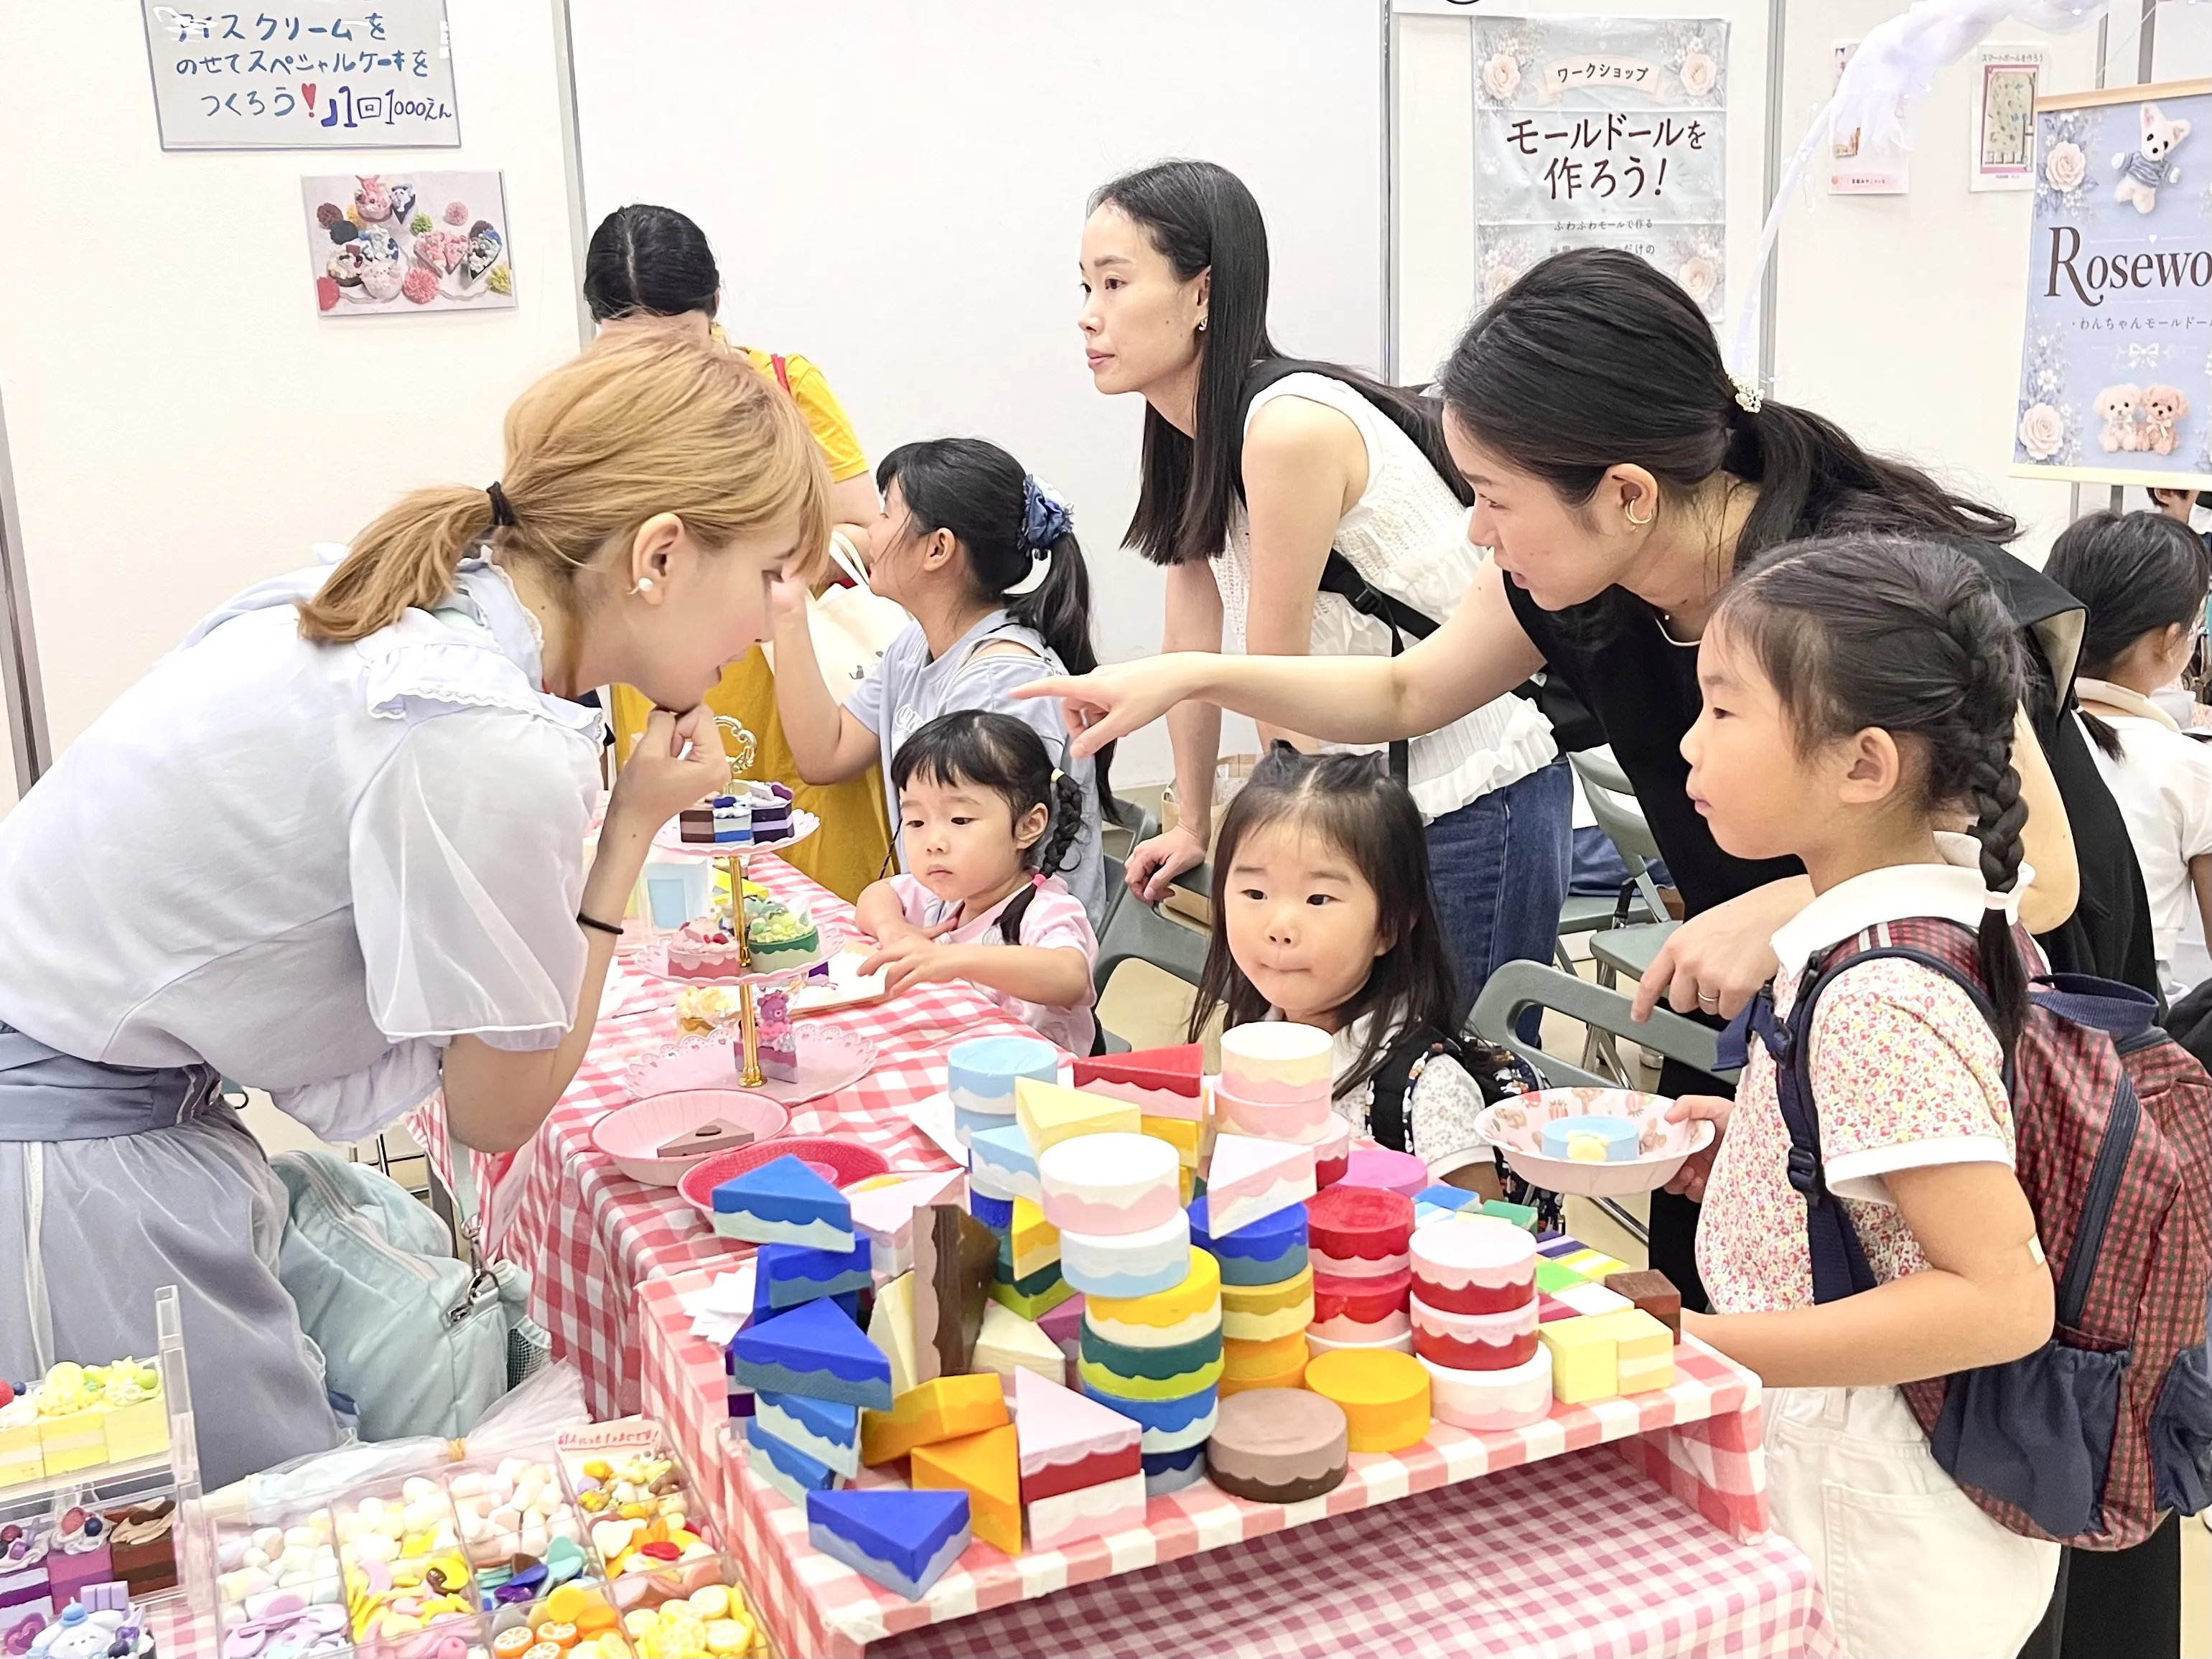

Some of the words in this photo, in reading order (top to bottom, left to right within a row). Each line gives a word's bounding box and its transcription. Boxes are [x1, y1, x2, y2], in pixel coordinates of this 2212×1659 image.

[176, 50, 428, 77] のせてスペシャルケーキを
[1557, 62, 1649, 83] ワークショップ
[1506, 113, 1707, 155] モールドールを
[1544, 156, 1667, 200] 作ろう!
[1554, 218, 1653, 231] ふわふわモールで作る
[2043, 226, 2212, 307] Rosewo
[2079, 316, 2212, 331] わんちゃんモールドー
